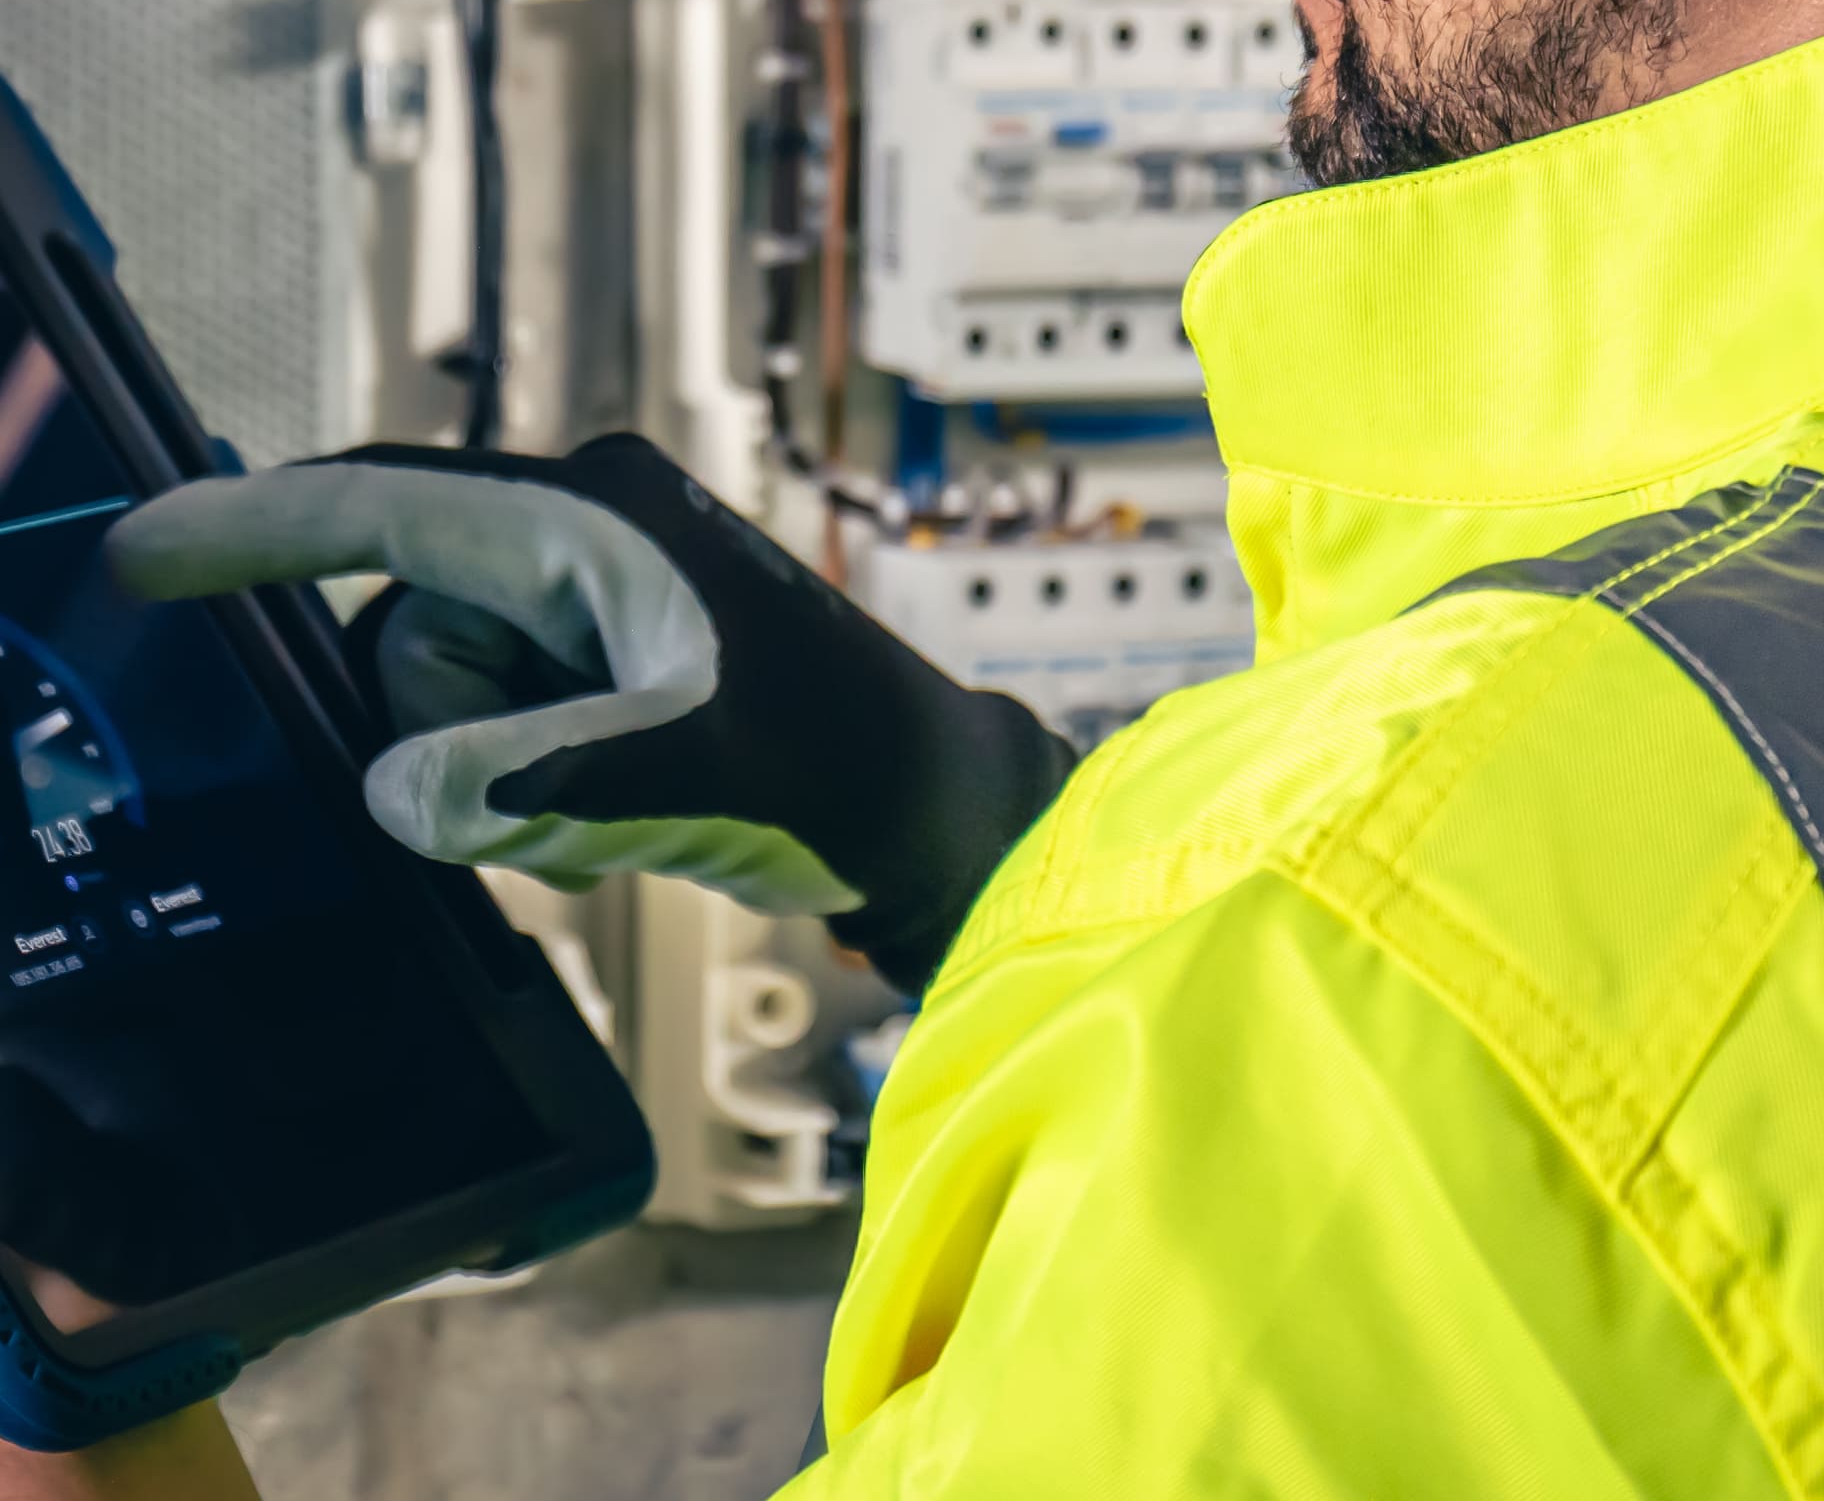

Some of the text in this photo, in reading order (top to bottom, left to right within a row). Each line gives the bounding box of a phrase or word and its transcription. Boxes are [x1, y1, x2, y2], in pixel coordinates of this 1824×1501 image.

[31, 819, 93, 863] 24.38
[149, 887, 202, 913] Everest
[14, 926, 67, 954] Everest
